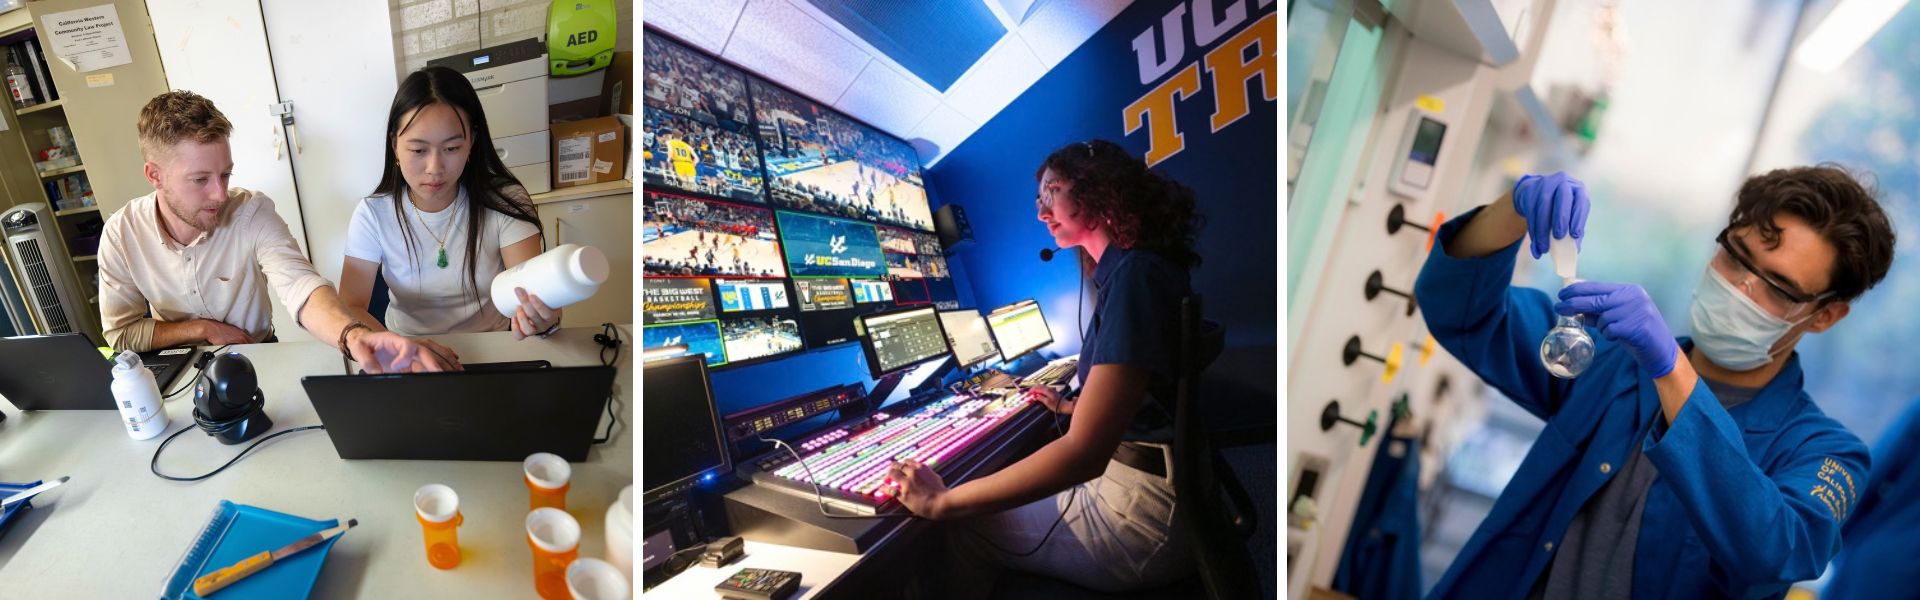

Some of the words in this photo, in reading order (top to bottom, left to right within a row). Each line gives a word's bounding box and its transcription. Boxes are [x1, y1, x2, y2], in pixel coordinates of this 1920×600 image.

[58, 18, 84, 27] California
[54, 26, 84, 36] Community
[566, 30, 598, 47] AED
[1132, 0, 1275, 85] UC
[647, 295, 700, 303] BASKETBALL
